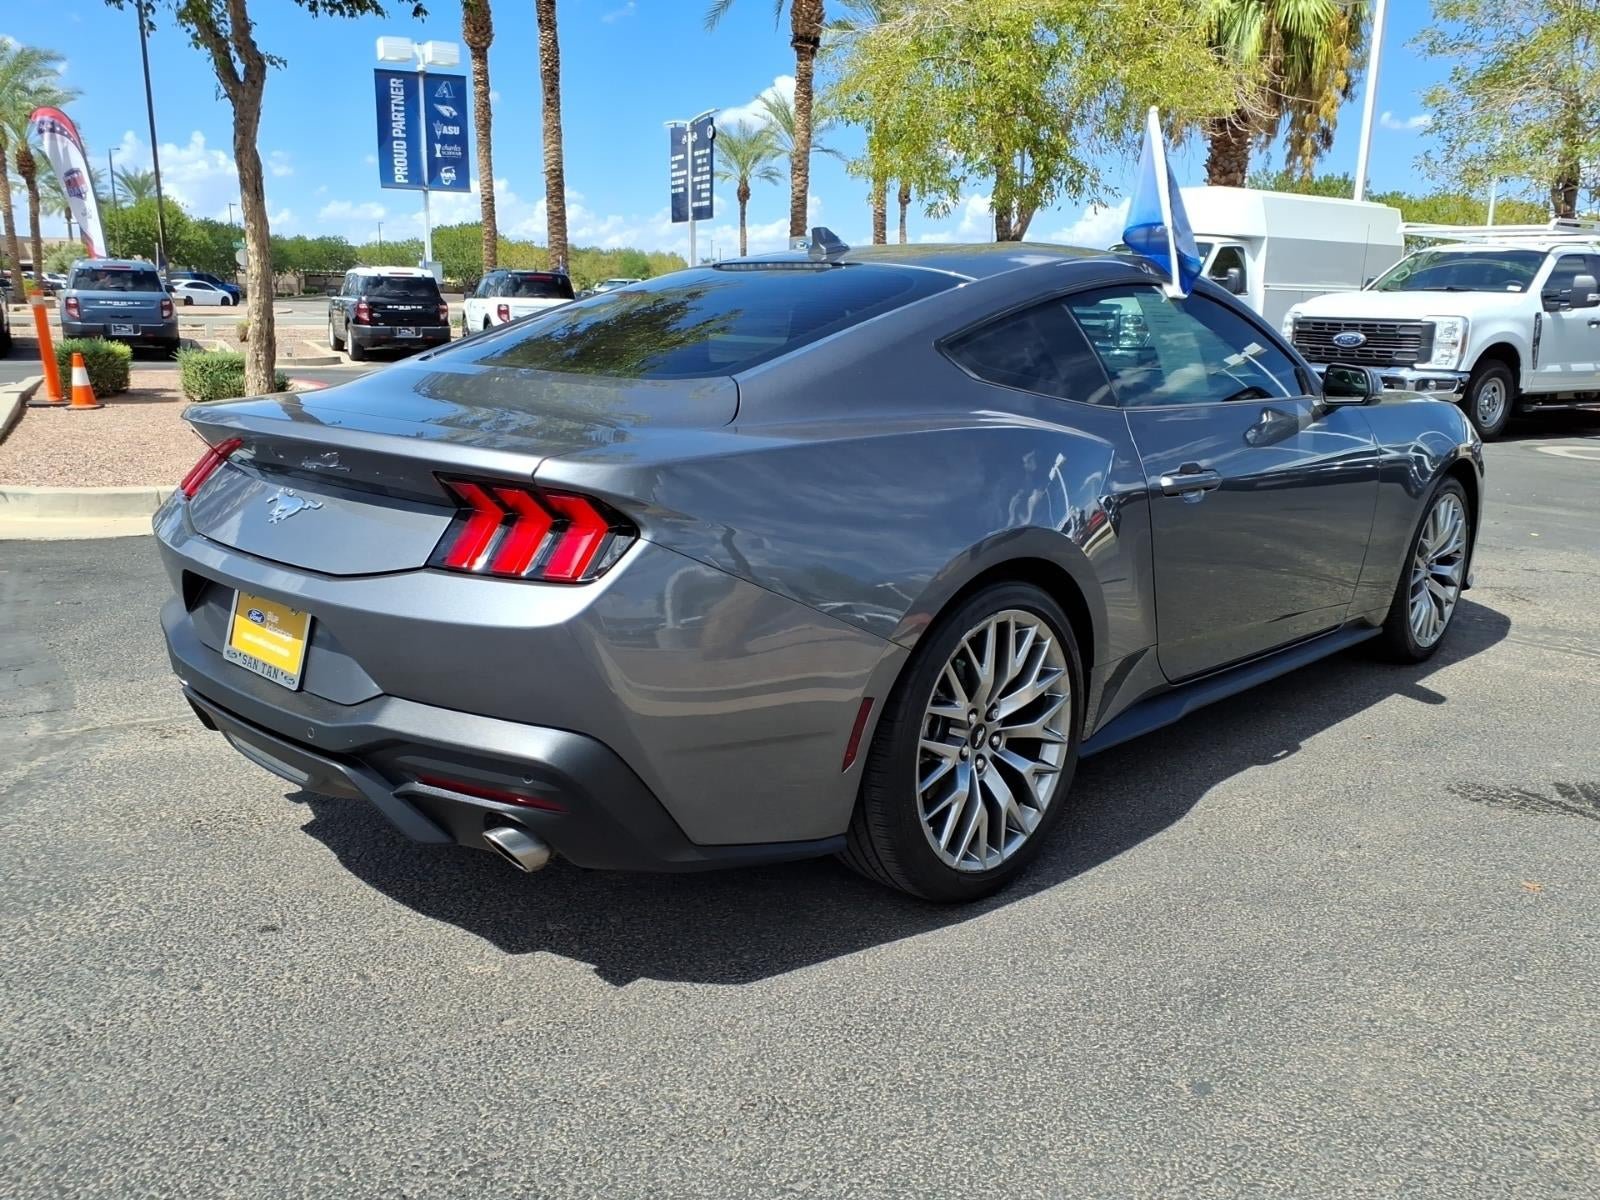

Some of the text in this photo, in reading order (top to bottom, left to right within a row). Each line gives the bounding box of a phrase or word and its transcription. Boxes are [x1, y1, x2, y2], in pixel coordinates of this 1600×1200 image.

[390, 78, 409, 183] PROUD PARTNER
[442, 125, 460, 135] ASU
[242, 655, 279, 680] SAN TAN
